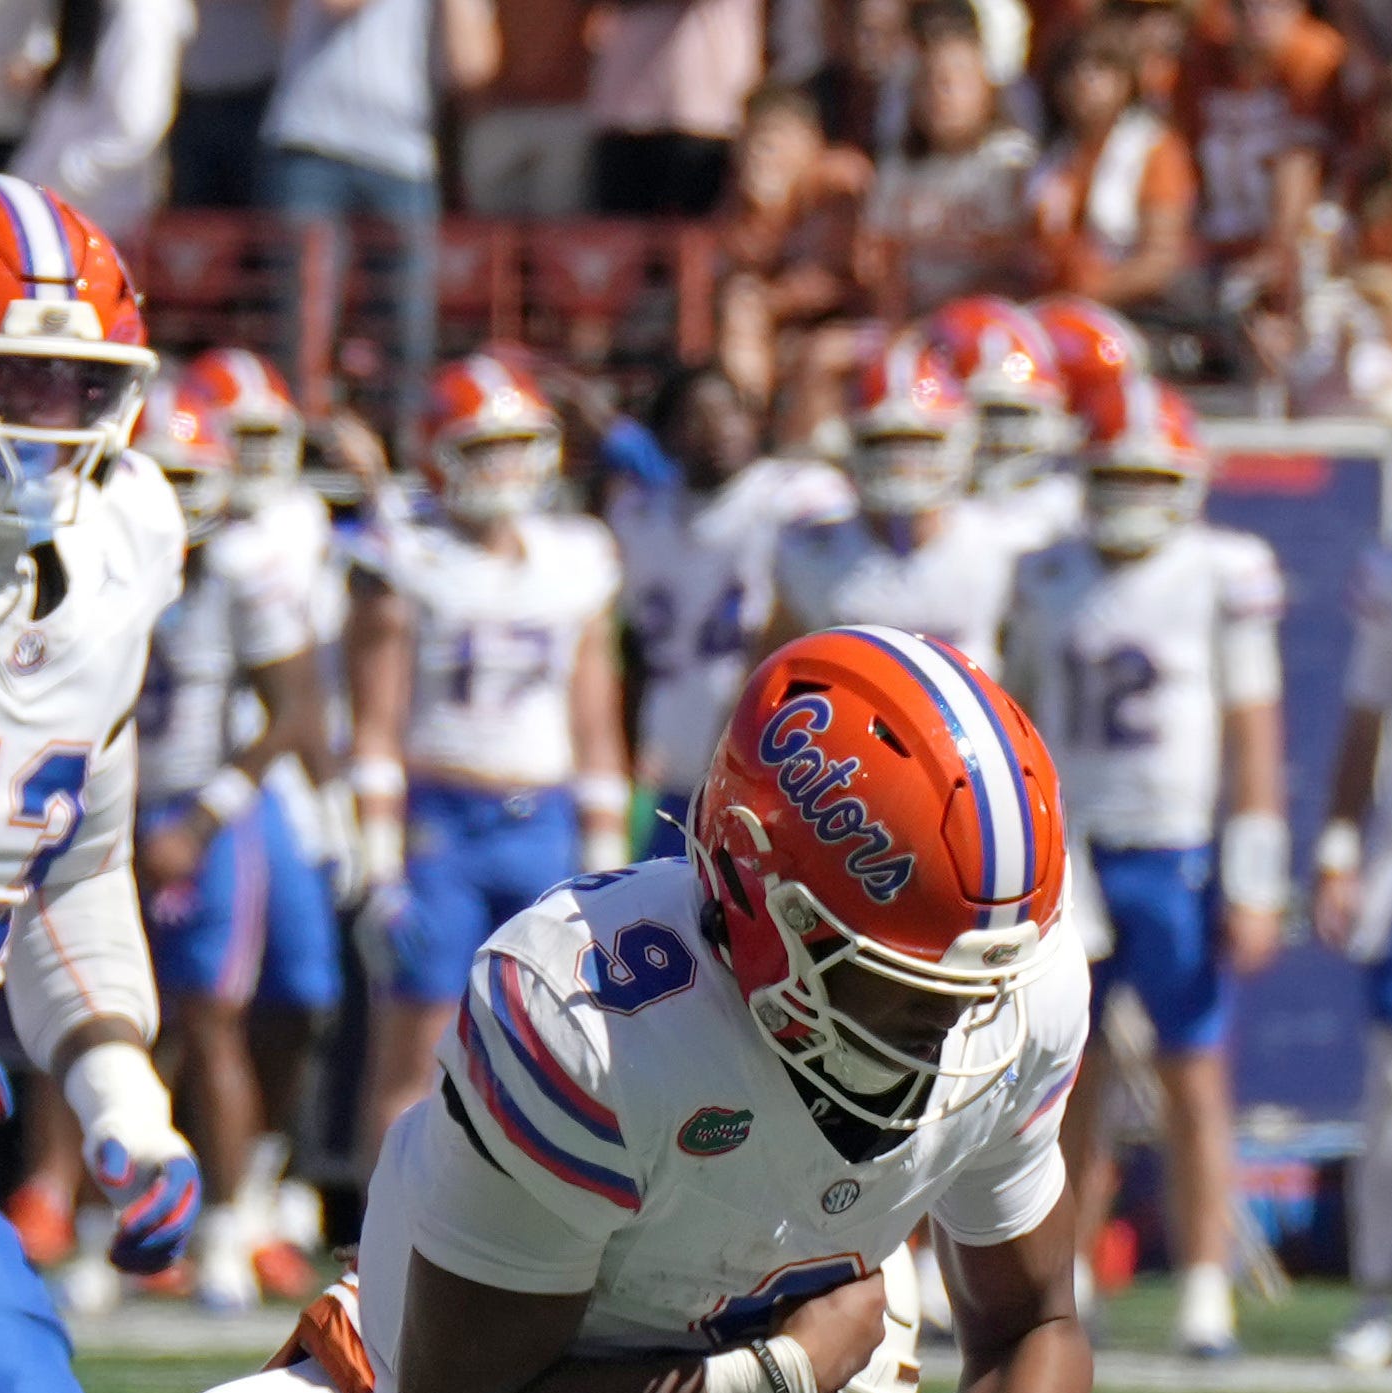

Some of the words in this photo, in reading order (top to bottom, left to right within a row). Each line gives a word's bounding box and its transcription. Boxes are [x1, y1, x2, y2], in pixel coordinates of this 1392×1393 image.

[1062, 640, 1159, 750] 12
[758, 694, 917, 905] Gators
[574, 918, 698, 1017] 9
